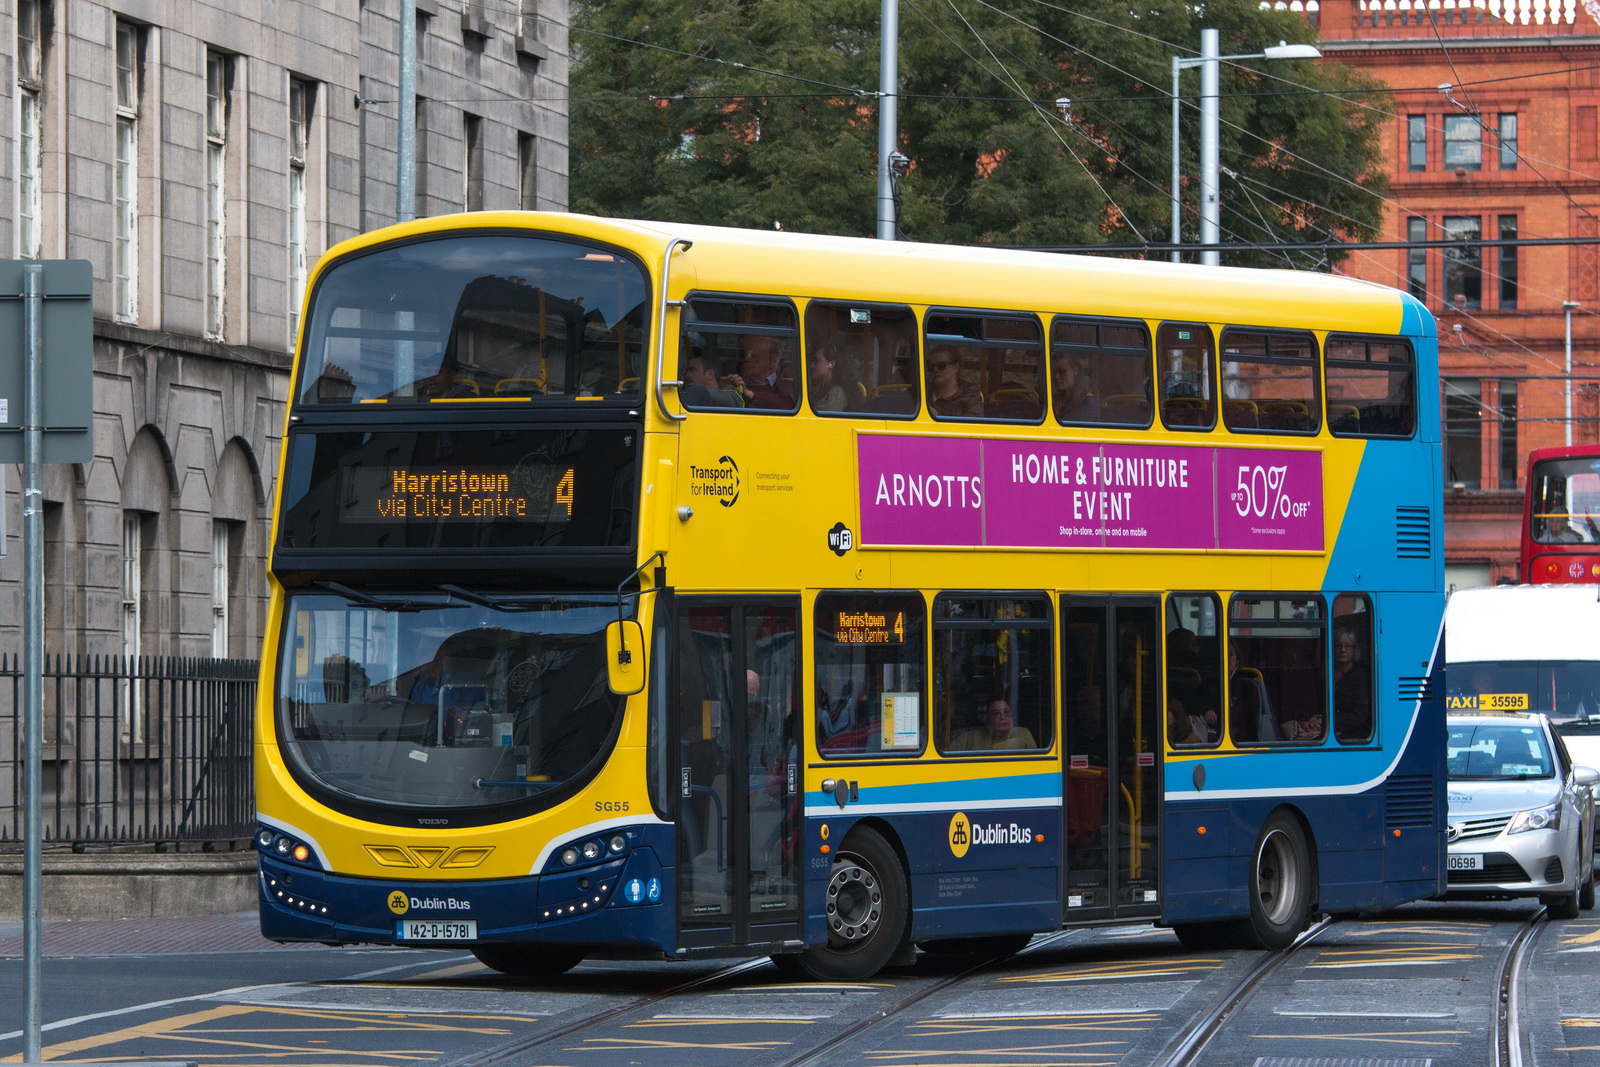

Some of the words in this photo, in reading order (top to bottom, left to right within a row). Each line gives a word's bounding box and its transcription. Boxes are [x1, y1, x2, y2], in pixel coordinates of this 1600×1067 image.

[690, 465, 733, 481] Transport
[756, 472, 780, 481] Connecting
[1012, 454, 1070, 484] HOME
[1075, 457, 1088, 485] &
[1092, 456, 1188, 487] FURNITURE
[393, 470, 509, 493] Harristown
[756, 484, 776, 492] transport
[555, 468, 574, 516] 4
[691, 483, 702, 495] for
[702, 483, 734, 496] Ireland
[875, 473, 982, 509] ARNOTTS
[1236, 465, 1291, 519] 50%
[377, 494, 406, 517] via
[413, 494, 451, 517] City
[459, 494, 526, 516] Centre
[1073, 491, 1132, 520] EVENT
[1059, 526, 1073, 537] Shop
[1073, 526, 1094, 536] in-store,
[1111, 527, 1121, 536] and
[1122, 528, 1129, 536] on
[1130, 527, 1148, 537] mobile
[840, 612, 886, 627] Harristown
[894, 611, 904, 643] 4
[837, 628, 848, 643] via
[849, 628, 864, 643] City
[864, 628, 889, 643] Centre
[1491, 696, 1524, 707] 35595
[594, 801, 630, 812] SG55
[972, 823, 1008, 845] Dublin
[1009, 823, 1032, 844] Bus
[811, 857, 829, 869] SG55
[410, 898, 447, 910] Dublin
[448, 898, 471, 911] Bus
[410, 924, 470, 938] 142-D-15781
